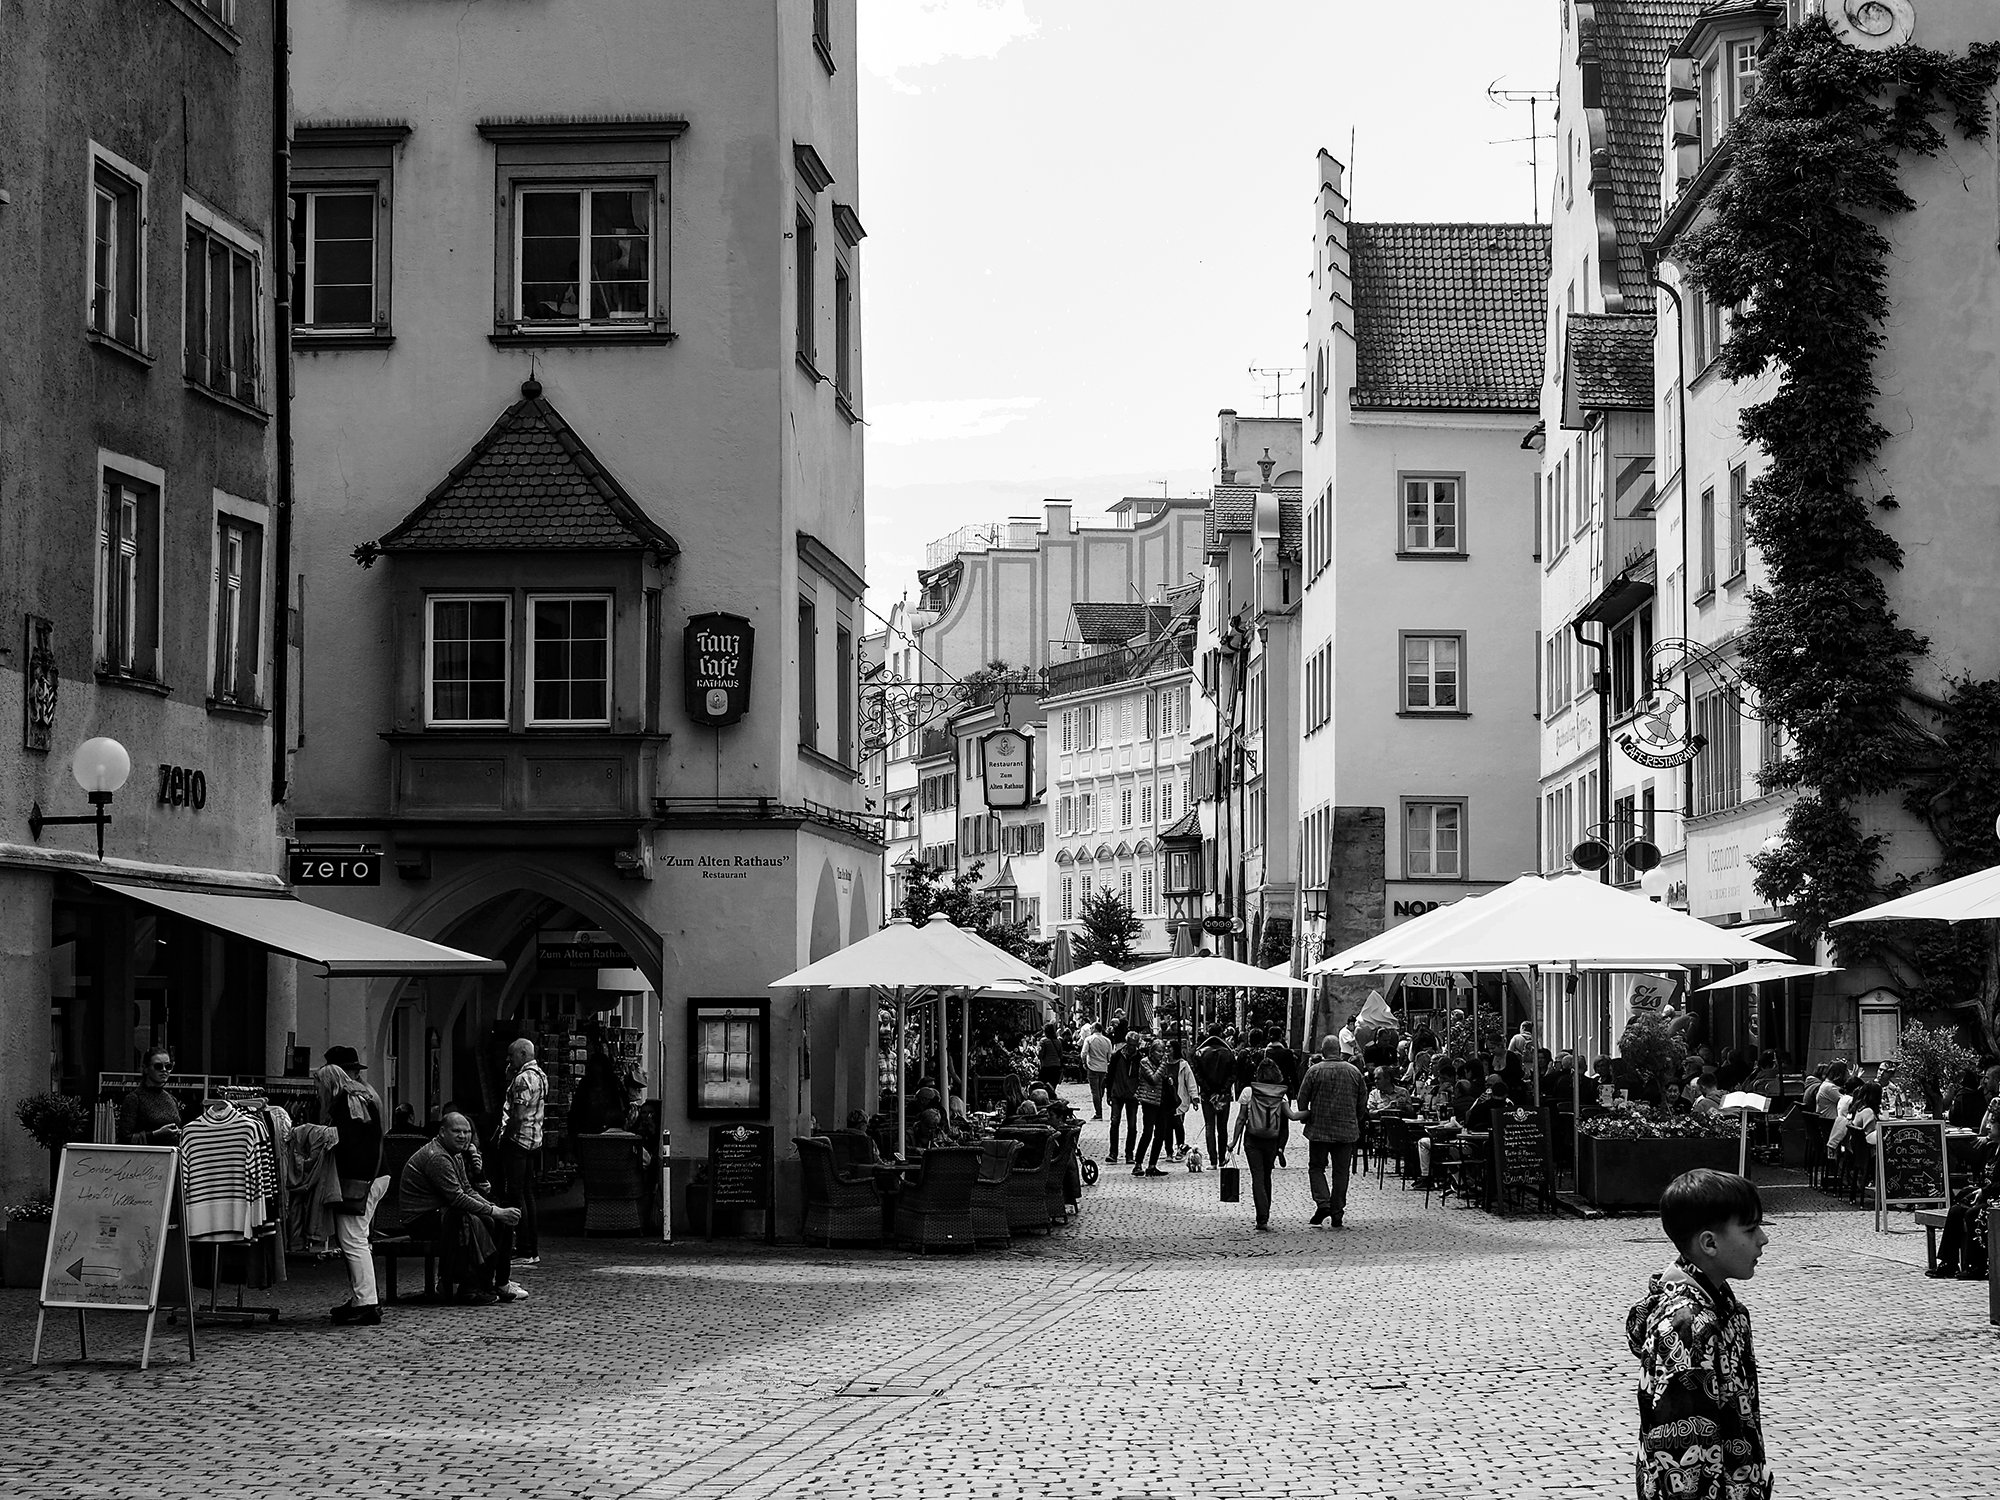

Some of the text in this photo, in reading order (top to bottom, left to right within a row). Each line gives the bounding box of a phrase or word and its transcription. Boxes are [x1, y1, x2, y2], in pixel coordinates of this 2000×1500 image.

[697, 628, 740, 655] Tanz
[697, 680, 739, 688] RATHAUS
[1624, 742, 1699, 768] CAFE-RESTAURANT
[158, 764, 206, 809] zero
[697, 855, 731, 867] Alten
[302, 862, 369, 878] zero
[702, 871, 747, 879] Restaurant
[540, 950, 561, 958] Zum
[564, 950, 590, 958] Alten
[1630, 985, 1662, 1007] Eis
